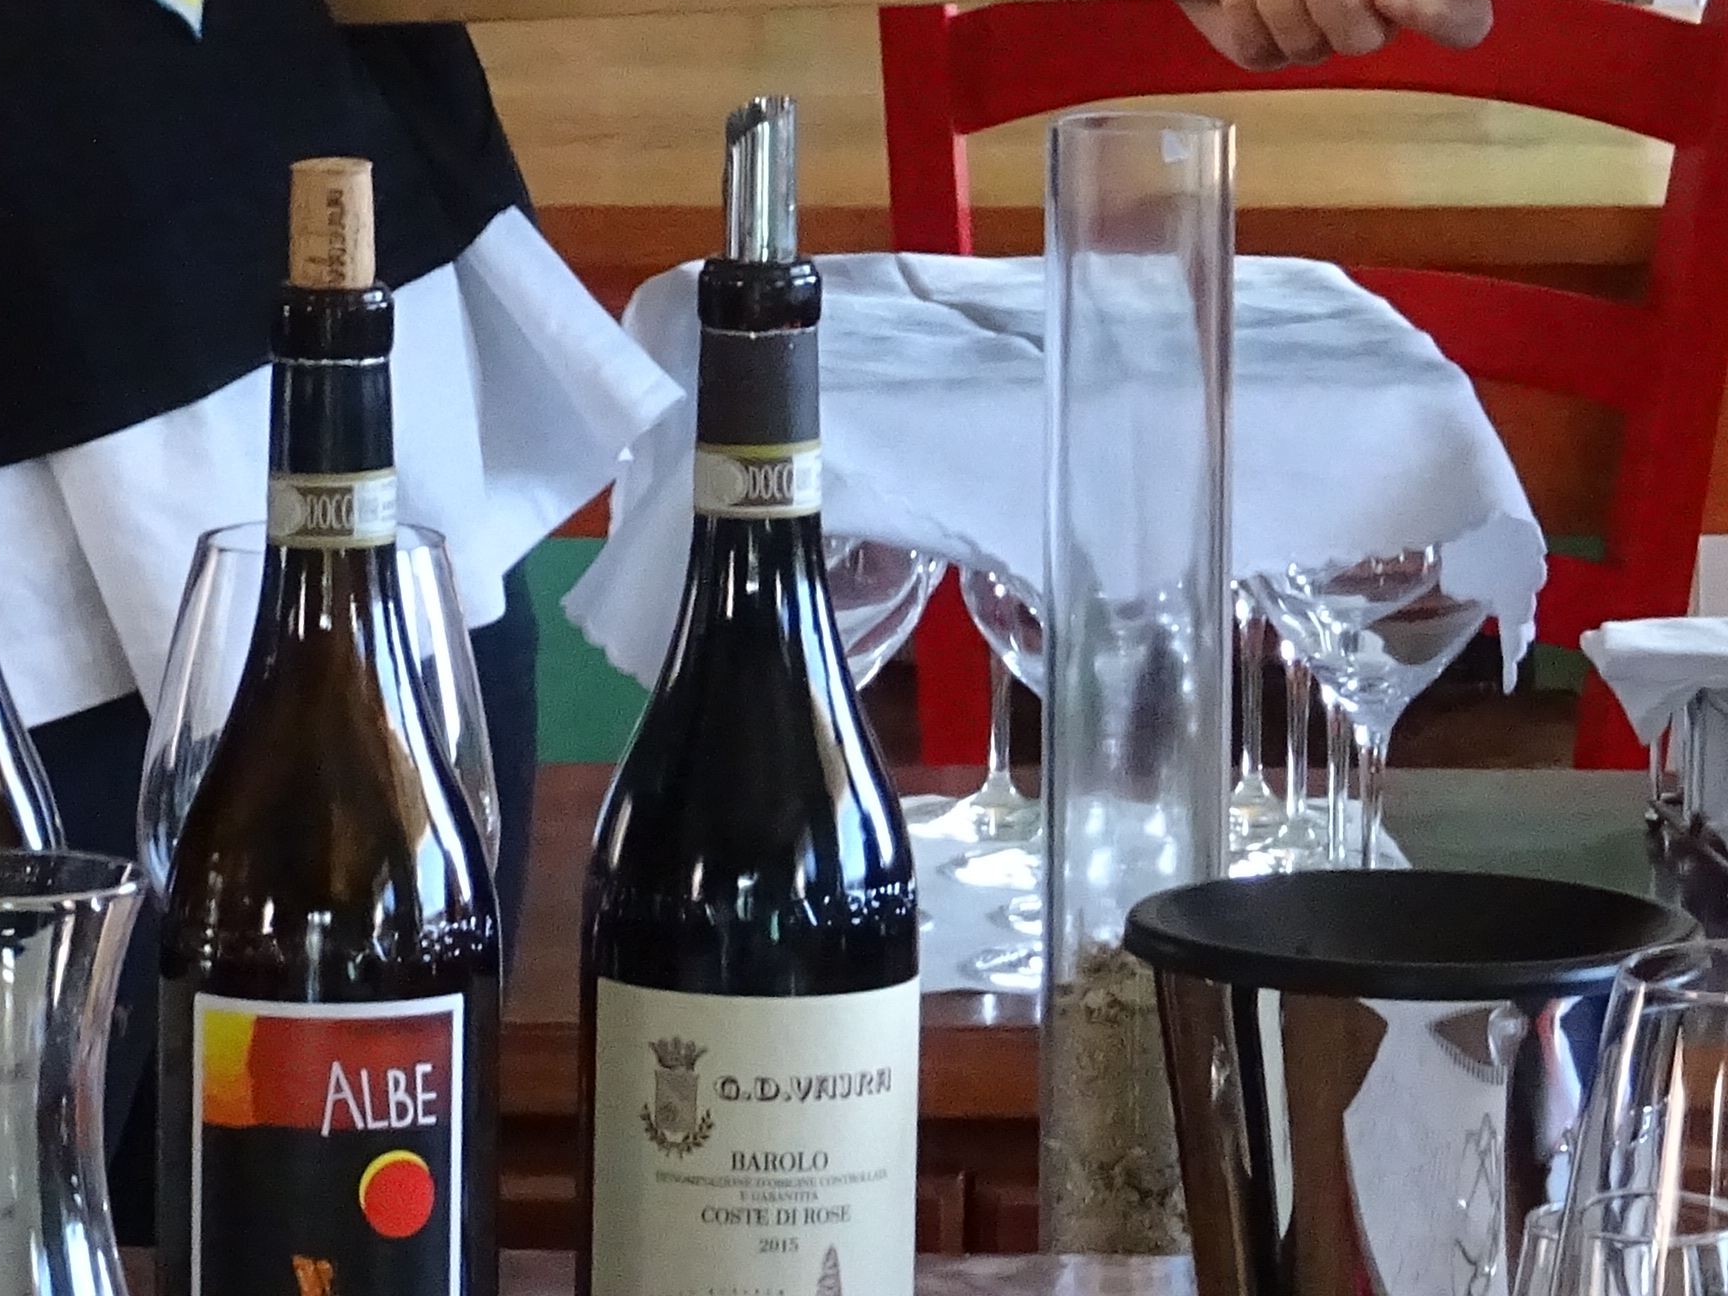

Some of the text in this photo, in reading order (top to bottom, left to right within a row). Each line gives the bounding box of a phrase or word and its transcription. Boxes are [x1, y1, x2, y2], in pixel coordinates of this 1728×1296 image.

[321, 1060, 438, 1137] ALBE
[731, 1151, 829, 1172] BAROLO
[701, 1204, 852, 1227] COSTE DI ROSE
[758, 1237, 799, 1253] 2015
